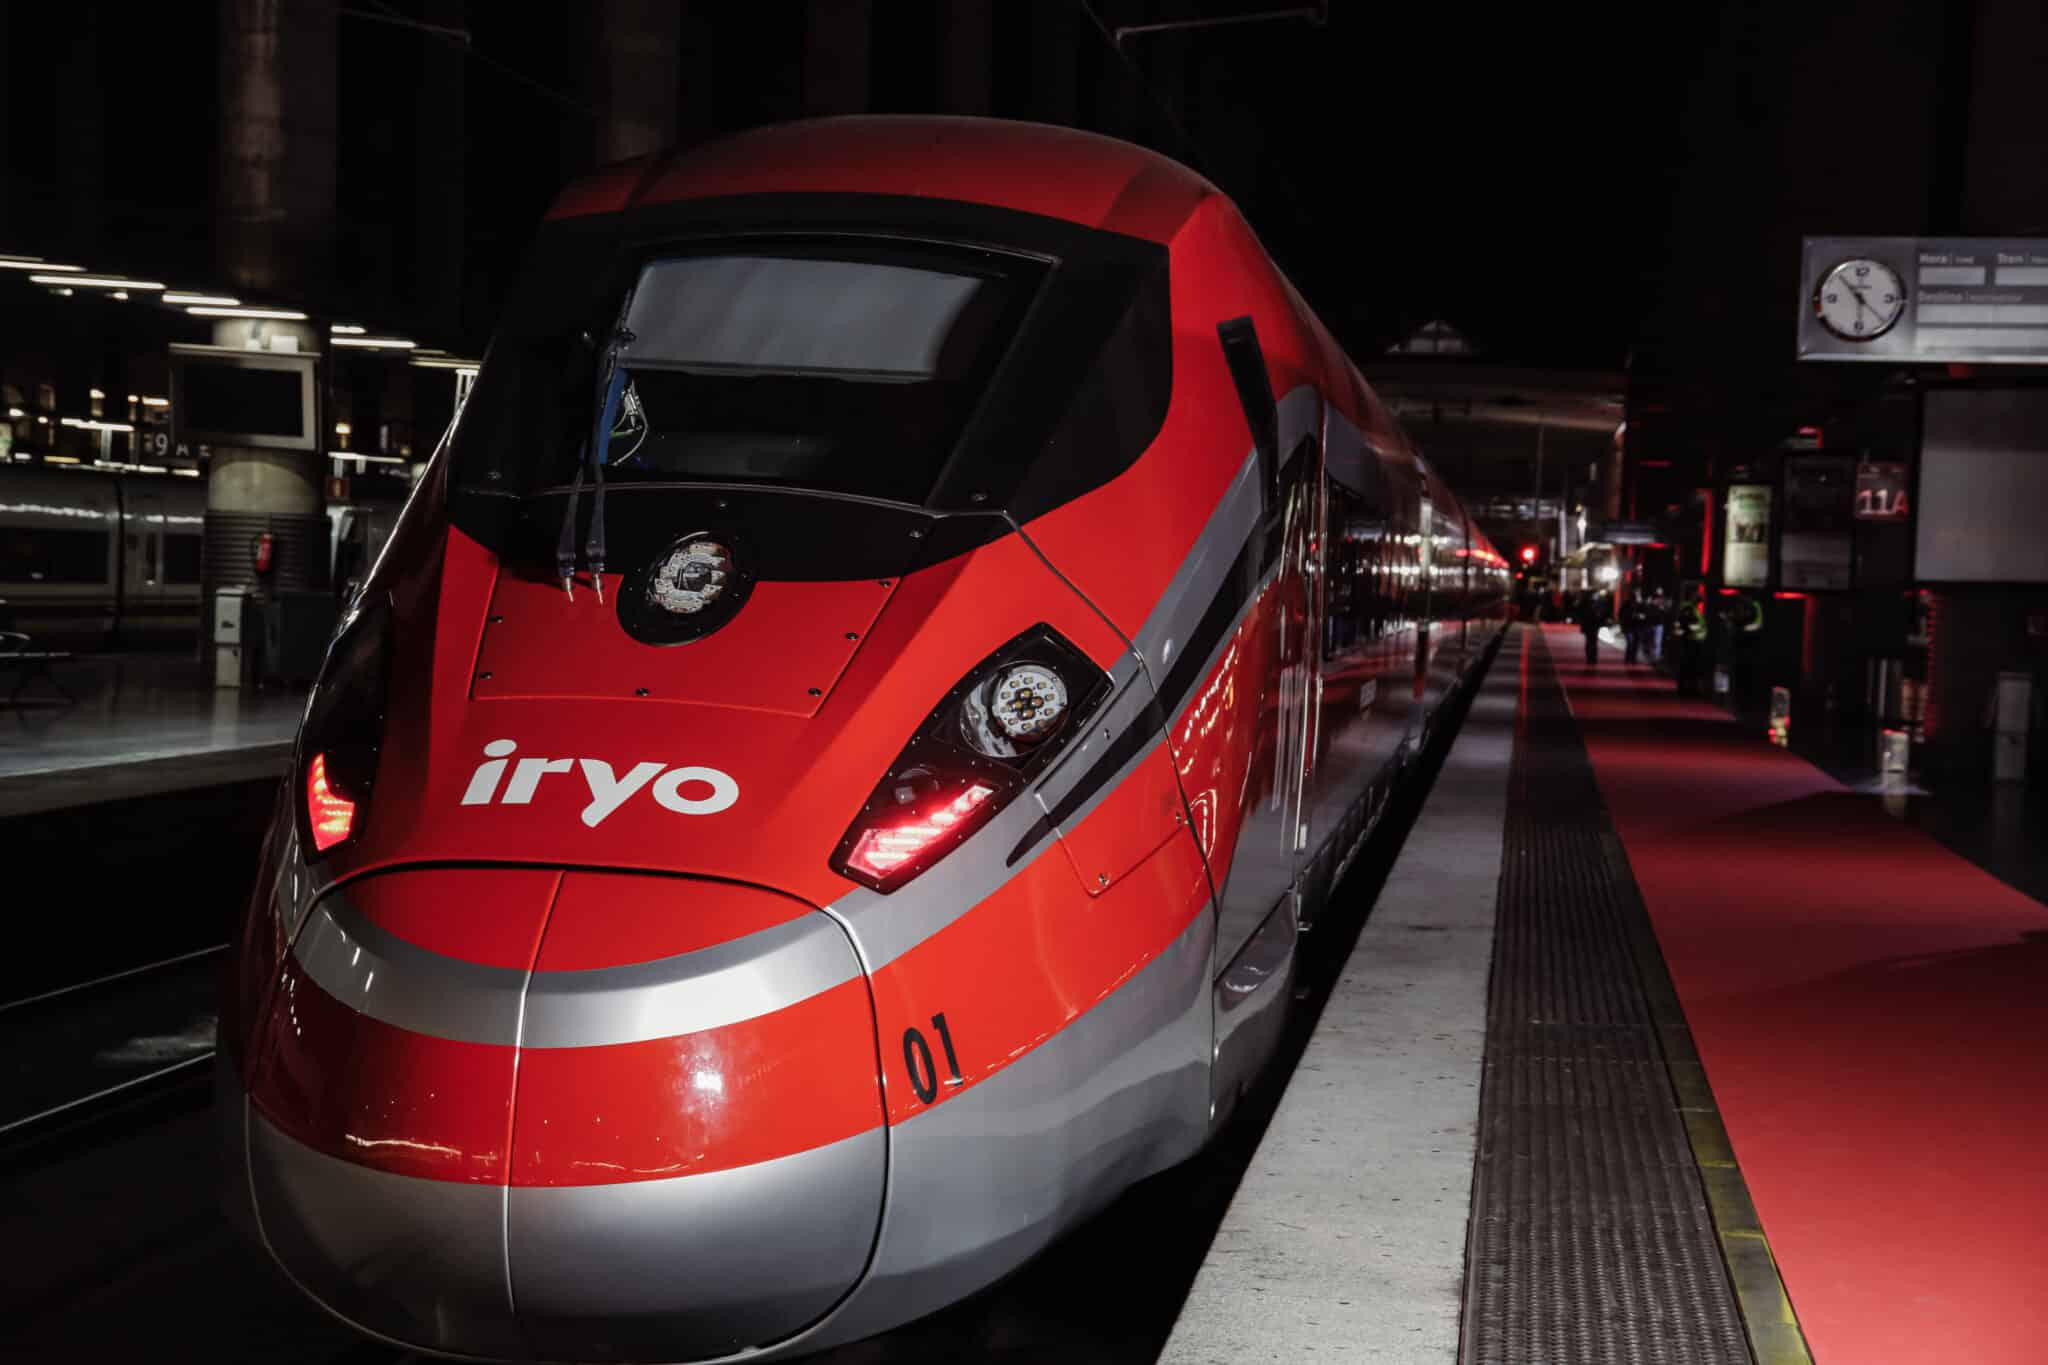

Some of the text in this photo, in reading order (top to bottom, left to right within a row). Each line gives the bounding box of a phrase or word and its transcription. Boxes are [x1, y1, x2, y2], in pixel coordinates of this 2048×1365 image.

[1858, 488, 1908, 515] 11A
[460, 738, 740, 828] iryo
[903, 1012, 963, 1104] 01
